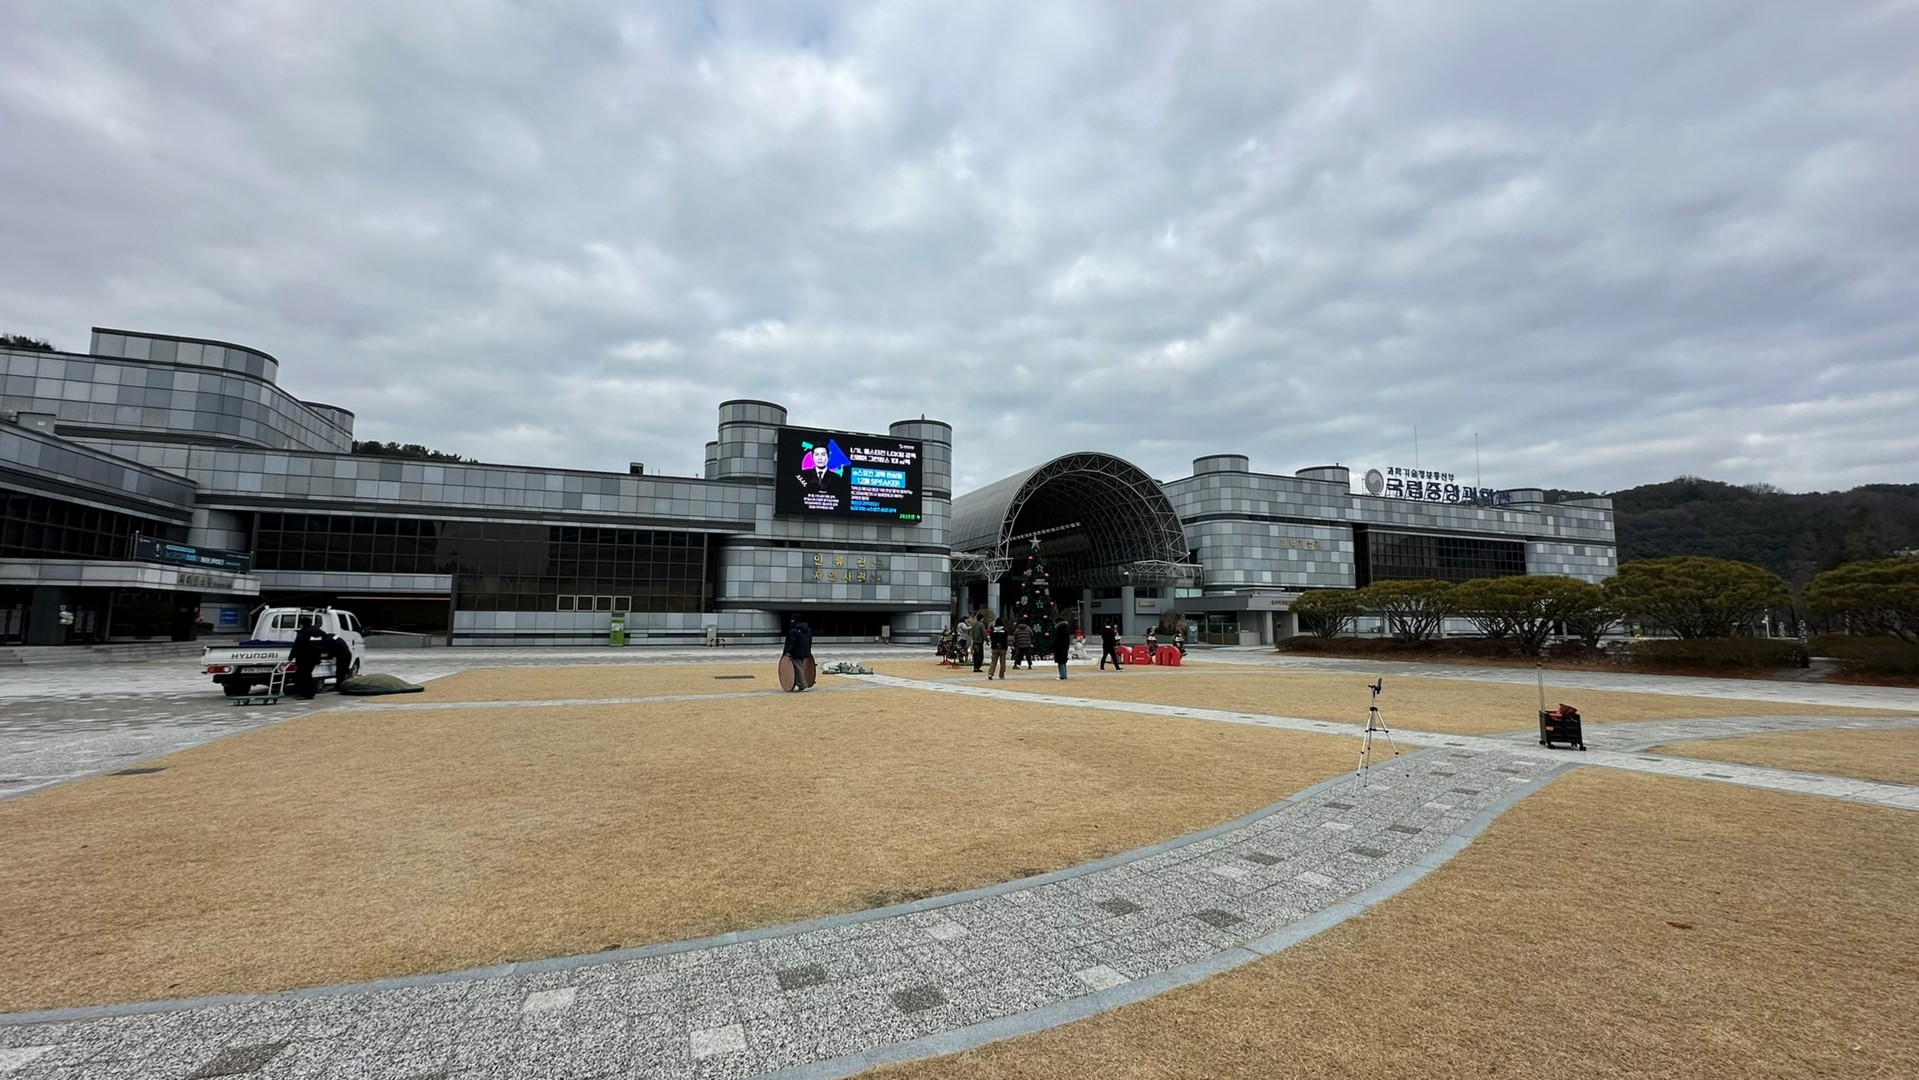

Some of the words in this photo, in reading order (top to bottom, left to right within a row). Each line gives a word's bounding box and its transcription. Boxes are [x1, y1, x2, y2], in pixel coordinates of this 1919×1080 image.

[1387, 467, 1455, 482] 과학기술정보통신부
[870, 478, 901, 487] SPEAKER
[813, 554, 866, 568] 인류관
[231, 652, 279, 660] HYUNDAI
